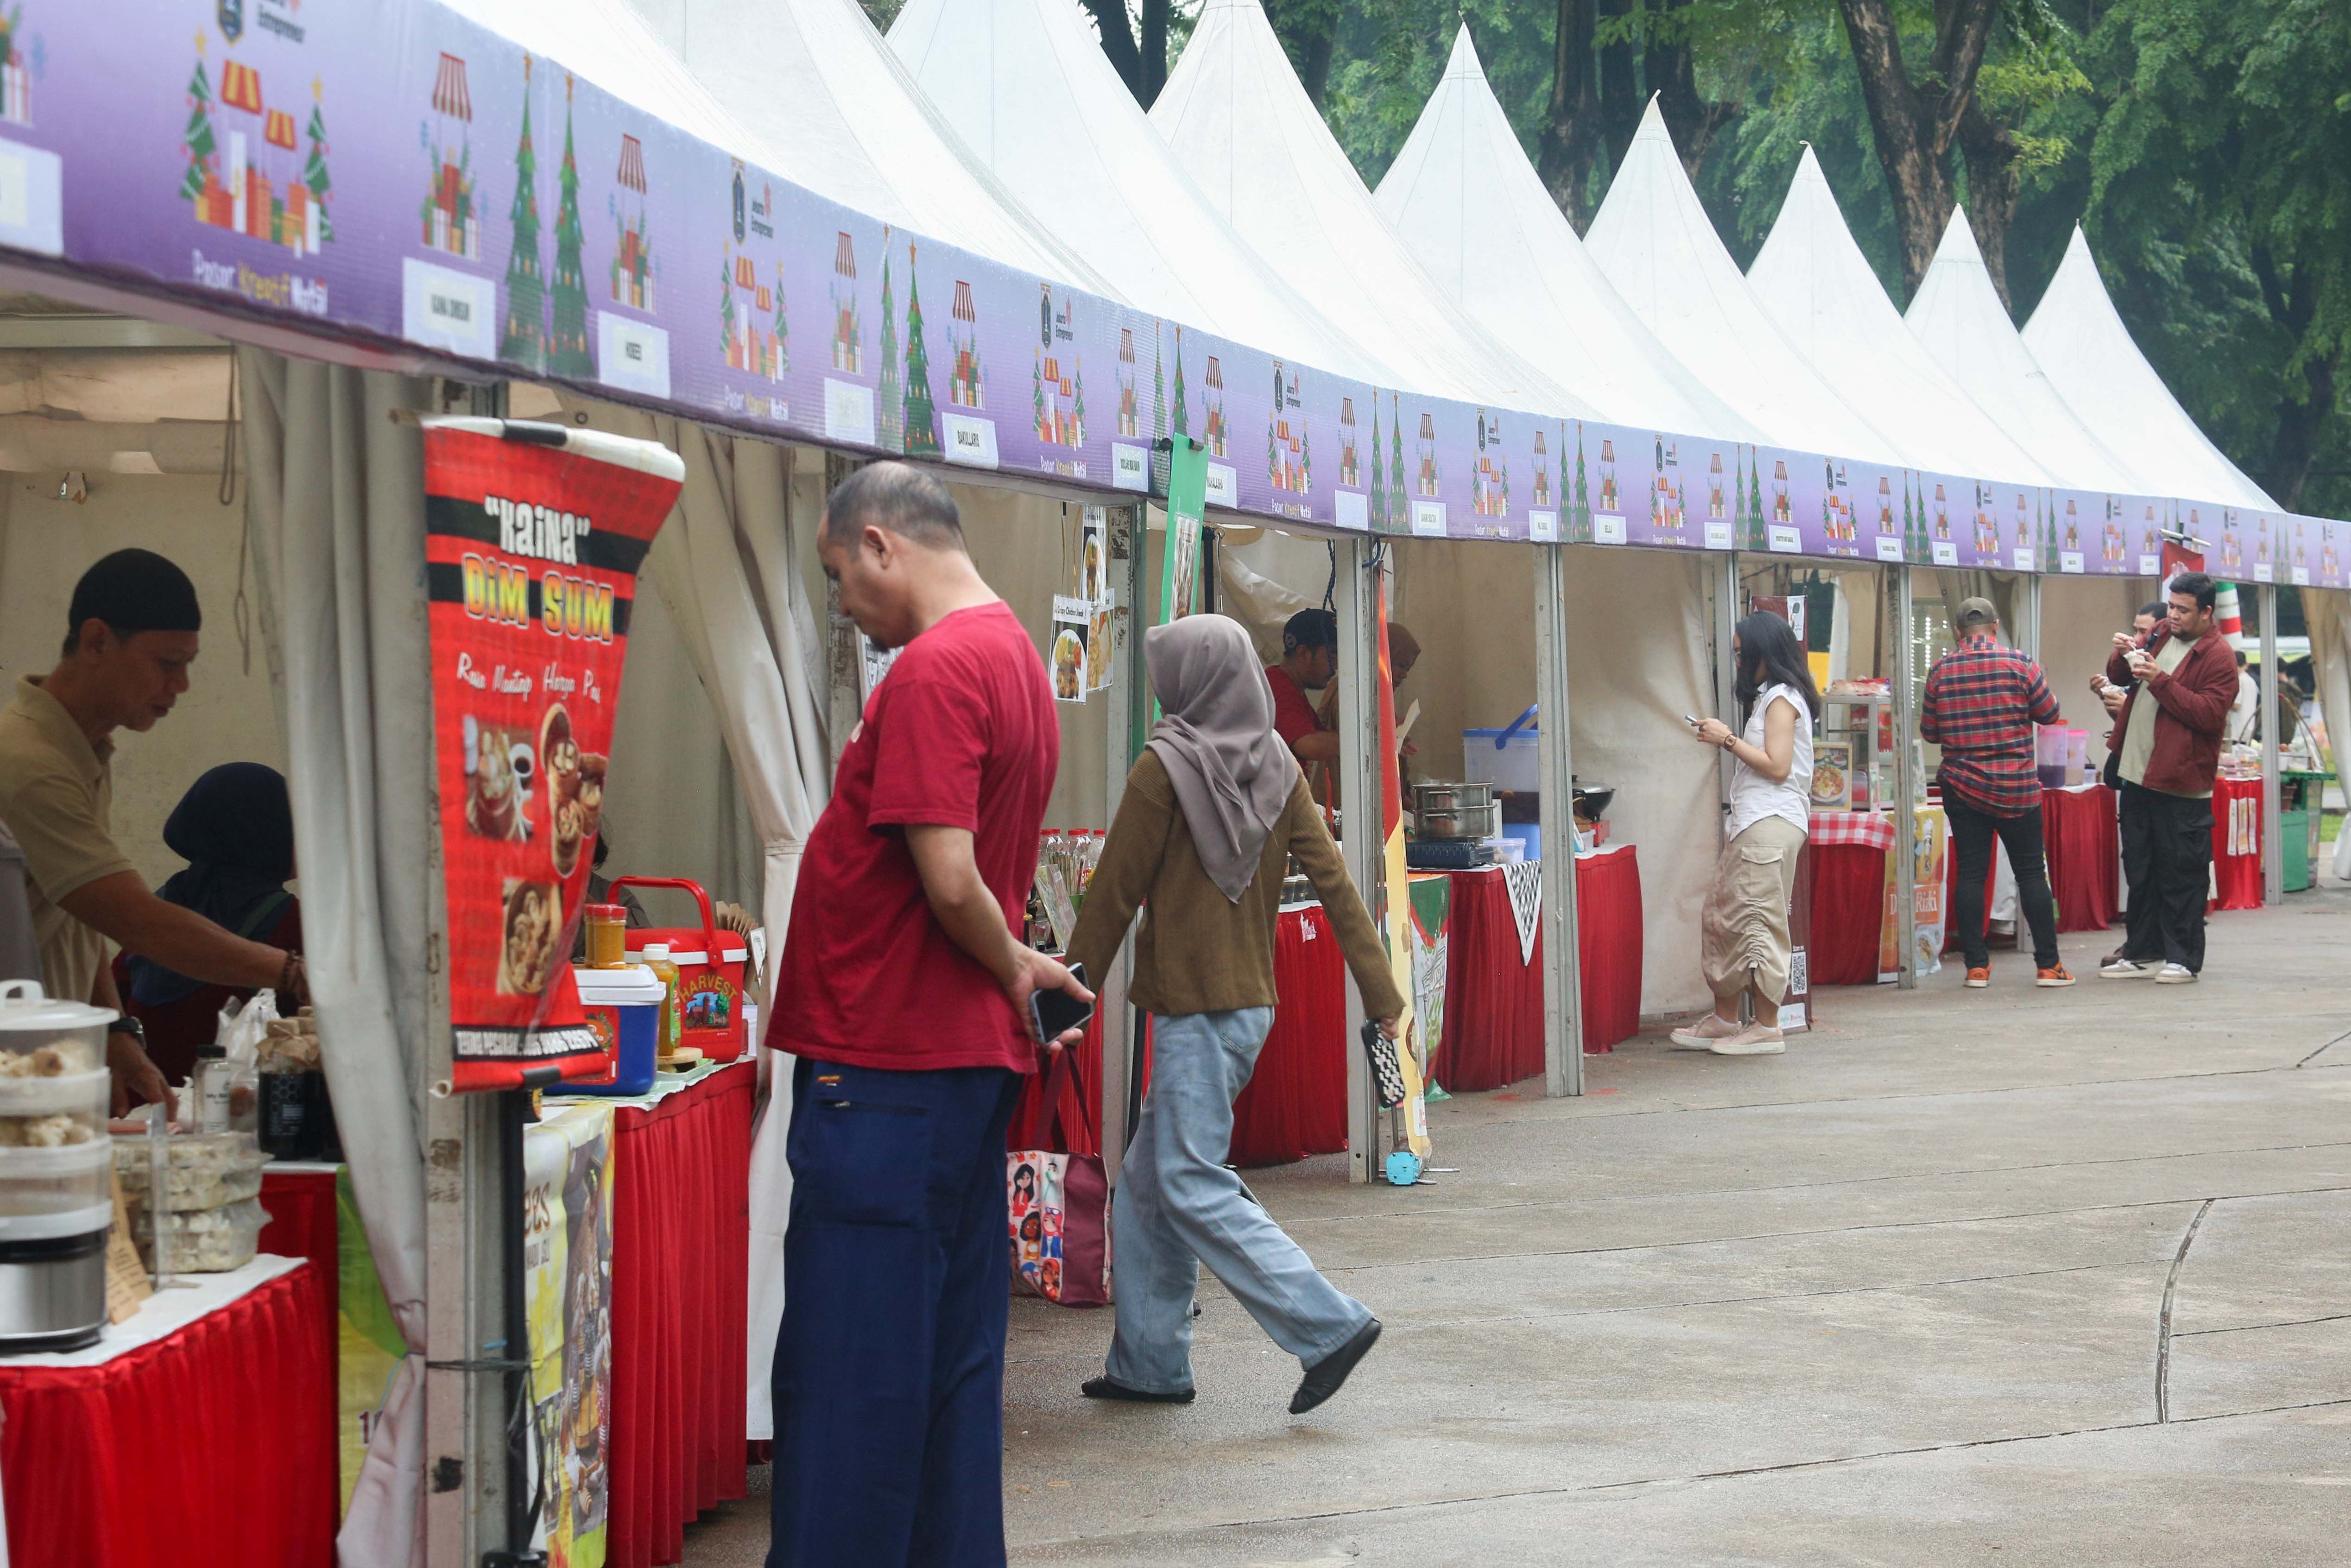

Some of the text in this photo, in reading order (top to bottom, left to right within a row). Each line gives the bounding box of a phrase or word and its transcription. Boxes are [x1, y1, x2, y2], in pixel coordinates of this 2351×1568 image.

[1041, 455, 1086, 479] Pasar Kreatif Natal
[1272, 498, 1311, 519] Pasar Kreatif Natal
[542, 570, 614, 645] SUM
[1066, 607, 1075, 615] Chicken
[679, 974, 738, 1004] HARVEST
